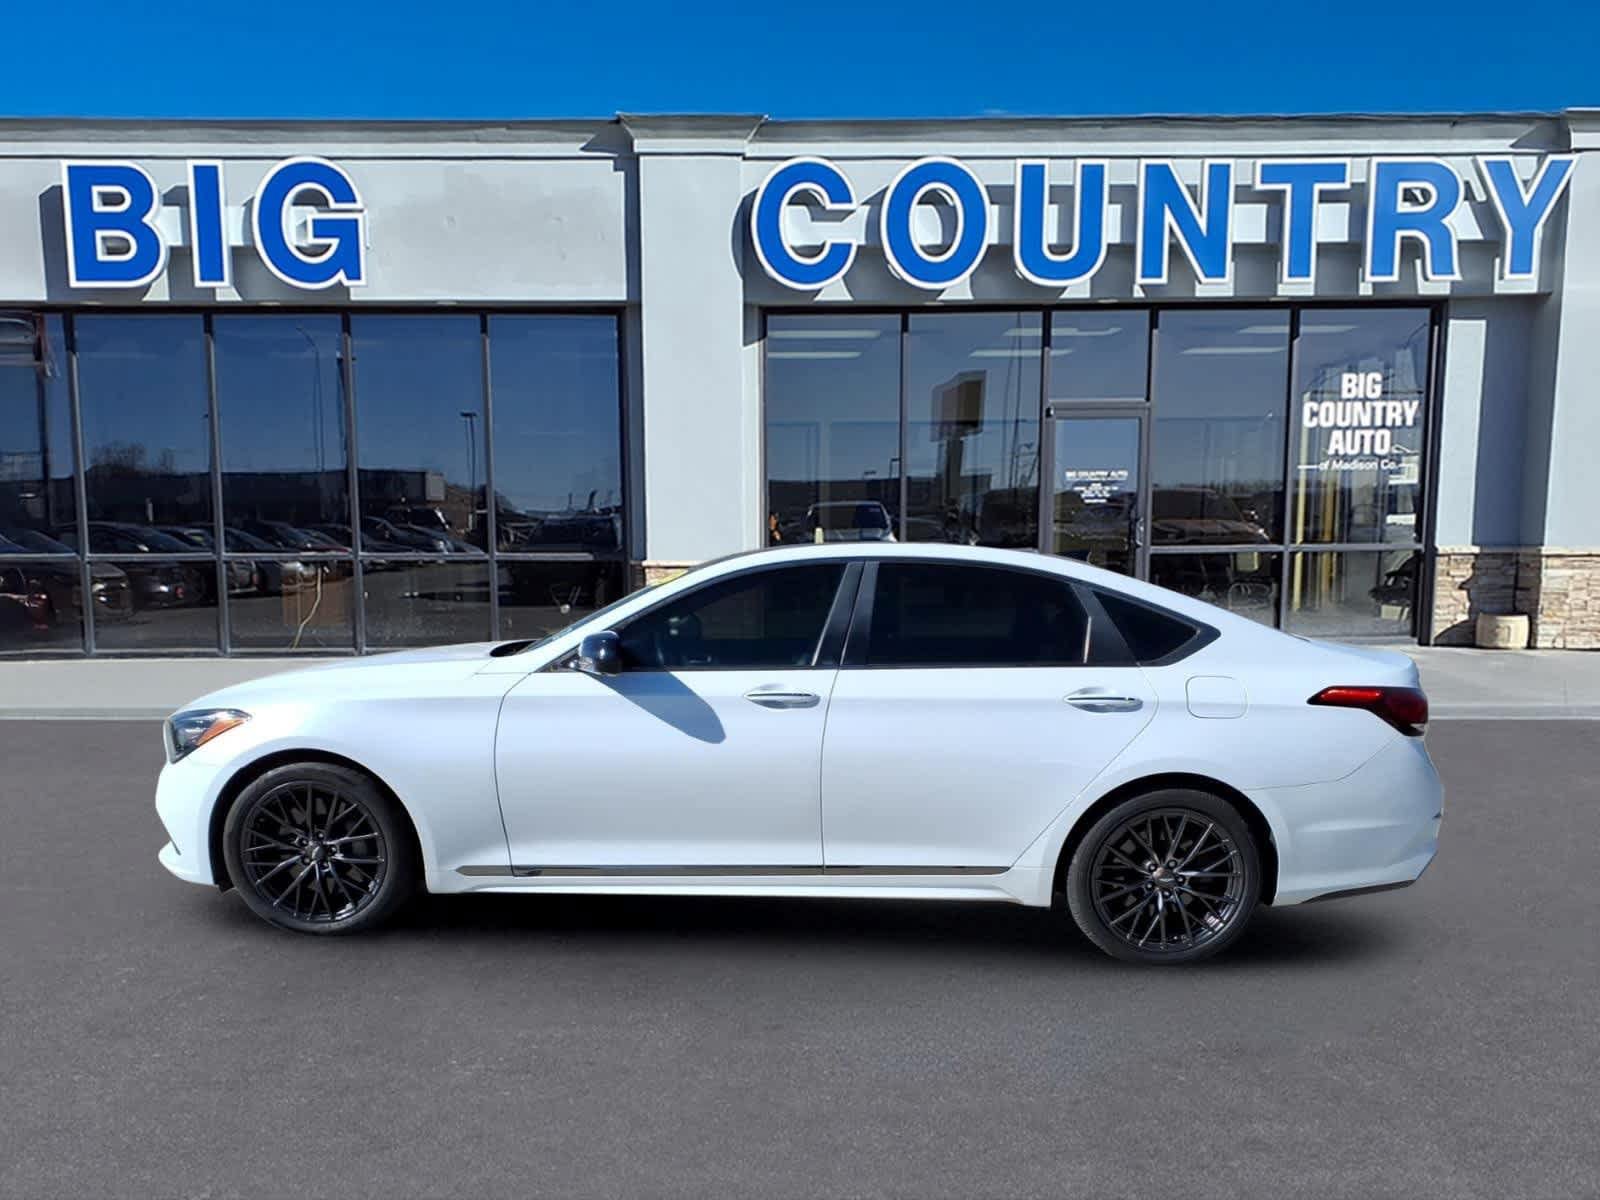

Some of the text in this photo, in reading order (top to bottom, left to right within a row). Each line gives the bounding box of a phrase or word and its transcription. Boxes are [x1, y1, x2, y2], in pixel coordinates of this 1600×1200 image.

[61, 154, 1575, 291] BIG COUNTRY
[1341, 372, 1382, 399] BIG
[1302, 400, 1419, 428] COUNTRY
[1327, 429, 1391, 455] AUTO
[1319, 459, 1330, 470] of
[1331, 459, 1377, 470] Madison
